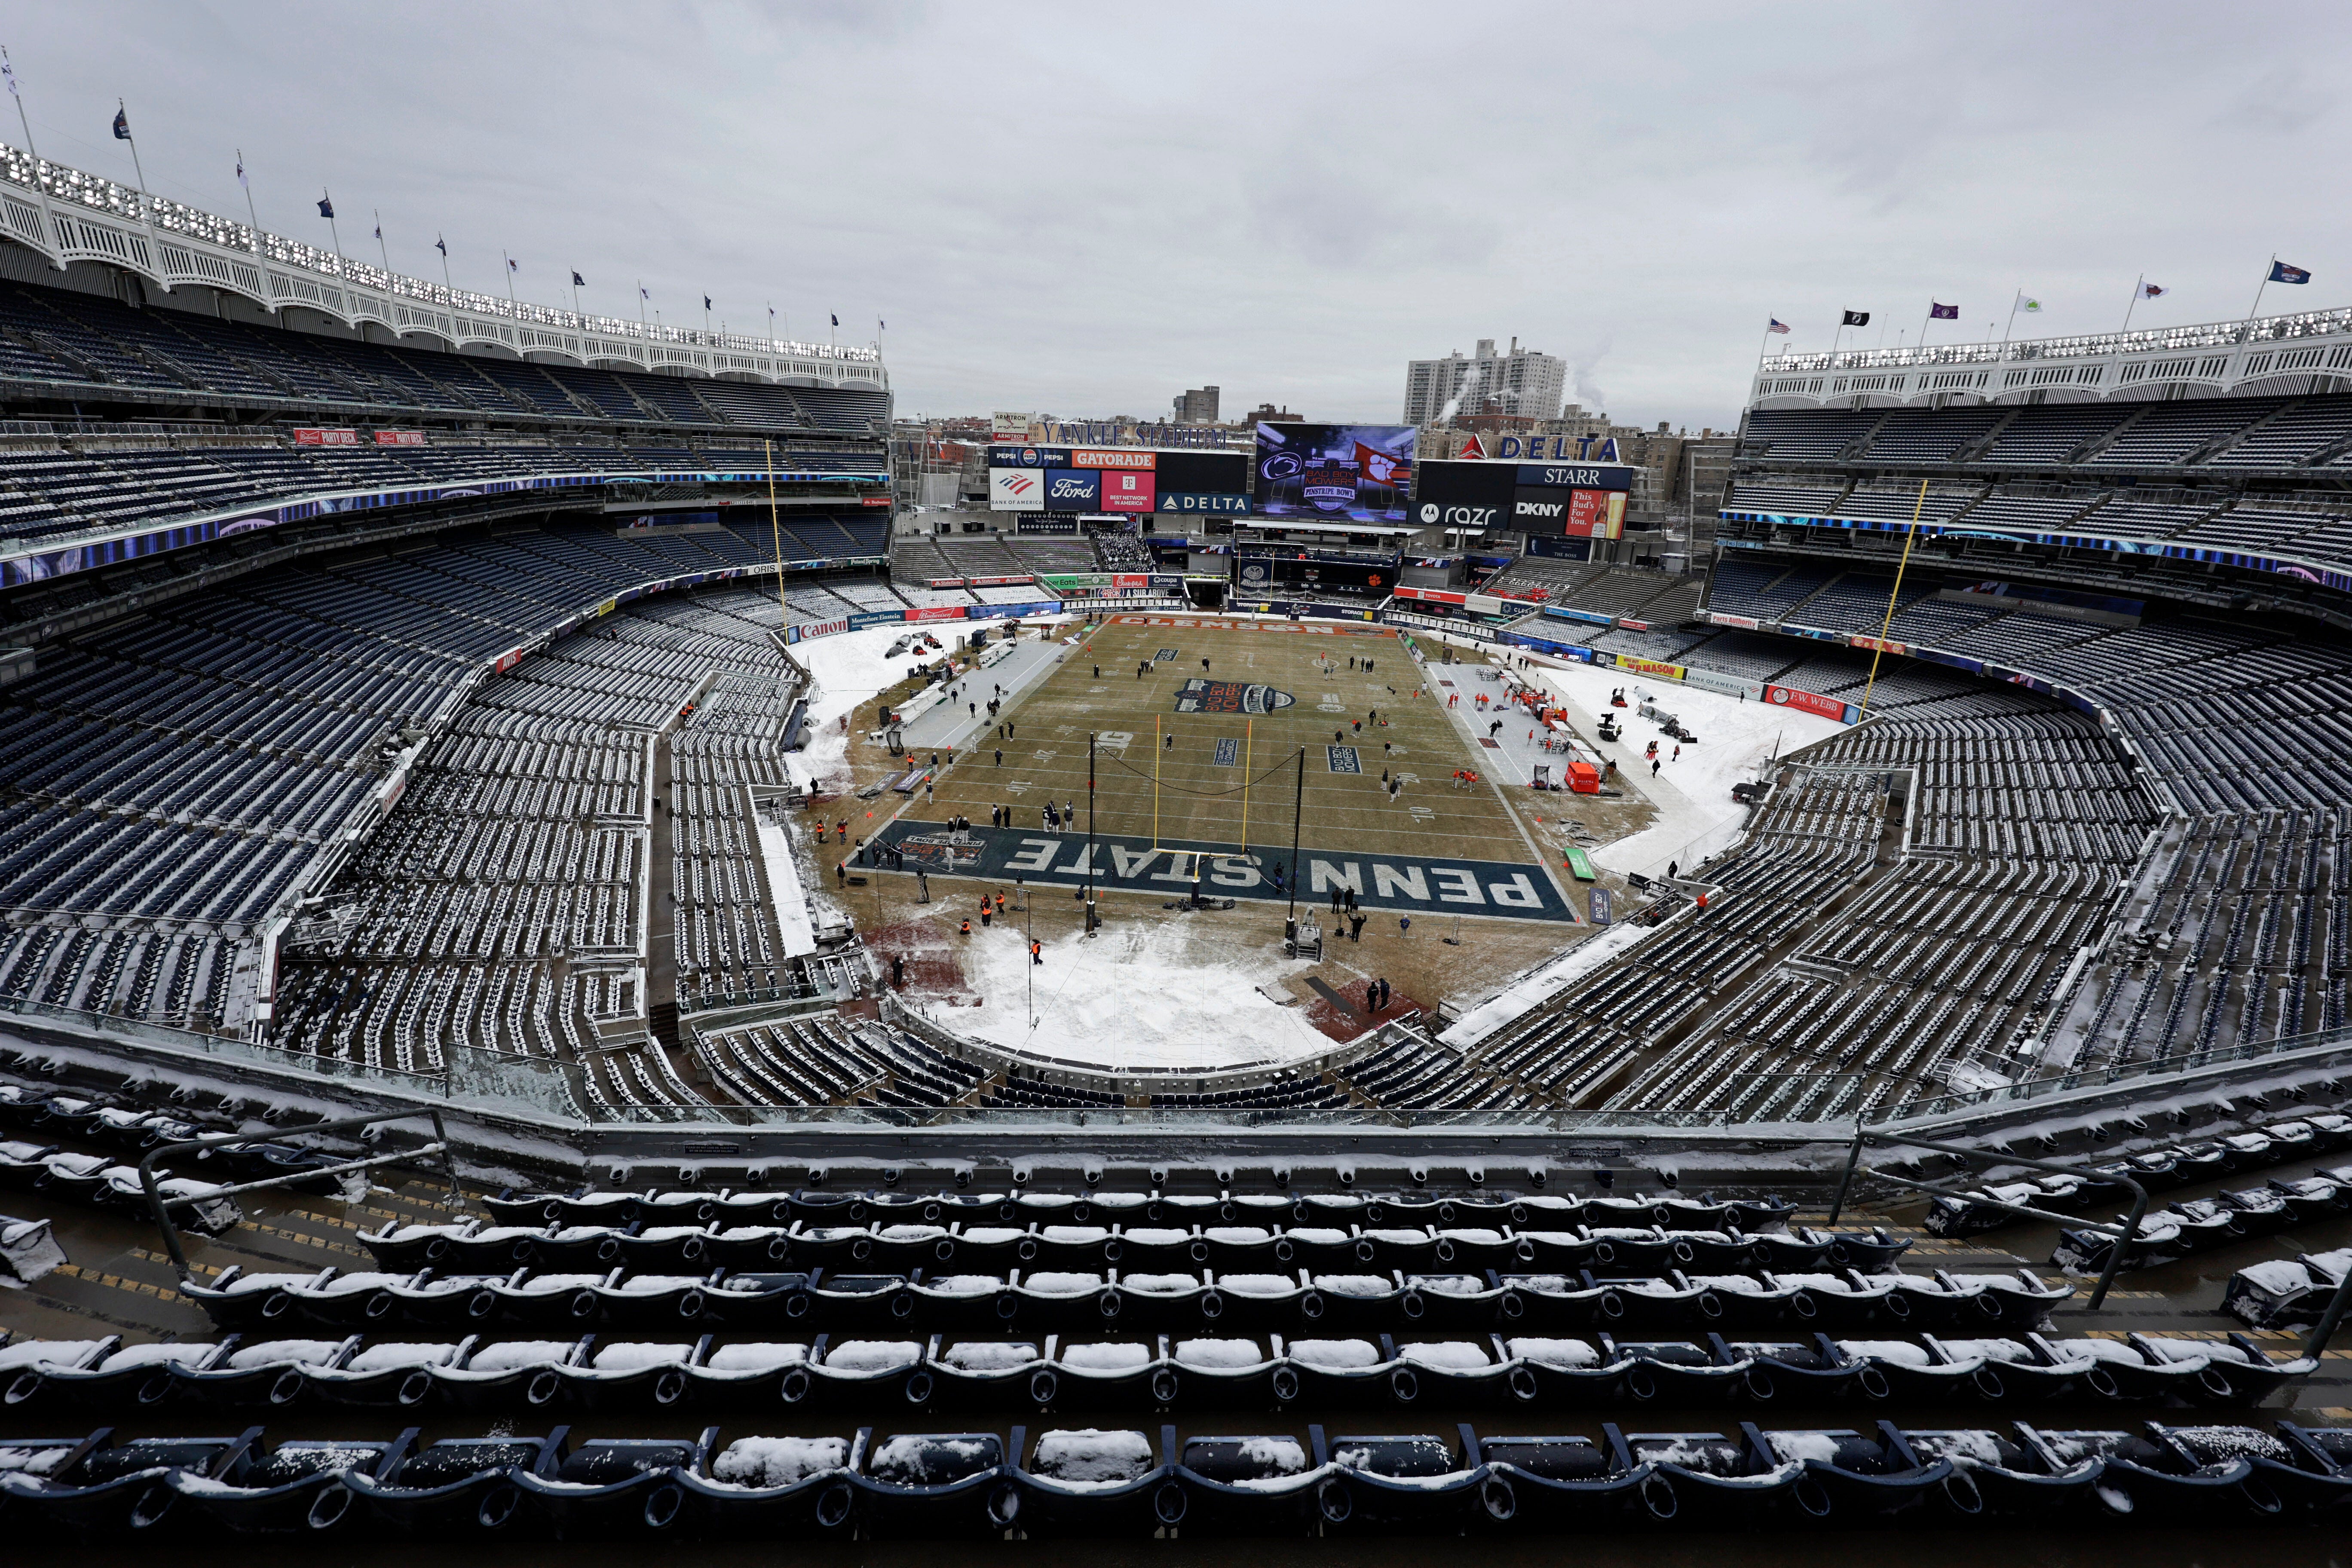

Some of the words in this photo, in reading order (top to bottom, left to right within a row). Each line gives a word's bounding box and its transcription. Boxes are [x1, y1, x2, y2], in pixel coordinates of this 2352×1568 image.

[322, 432, 340, 443] PARTY
[341, 432, 356, 443] DECK
[395, 434, 411, 443] PARTY
[411, 434, 423, 443] DECK
[1043, 423, 1122, 445] YANKEE
[1135, 426, 1227, 450] STADIUM
[1501, 437, 1621, 462] DELTA
[1077, 453, 1152, 467] GATORADE
[1305, 478, 1355, 486] MOWERS
[1544, 469, 1600, 485] STARR
[1051, 479, 1094, 499] Ford
[1305, 488, 1334, 496] PINSTRIPE
[1336, 489, 1354, 497] BOWL
[1574, 492, 1592, 500] This
[1184, 496, 1246, 510] DELTA
[1572, 500, 1594, 509] Bud's
[1516, 502, 1563, 517] DKNY
[1571, 508, 1585, 517] For
[1445, 507, 1497, 525] razr
[1570, 517, 1587, 525] You.
[753, 565, 775, 574] ORIS
[1126, 589, 1131, 597] A
[1133, 589, 1146, 597] SUB
[1148, 589, 1169, 597] ABOVE
[919, 611, 951, 620] Budweiser
[2047, 604, 2085, 615] CLUBHOUSE
[1728, 617, 1756, 627] Authority
[801, 620, 847, 639] Canon
[502, 652, 516, 669] AVIS
[1643, 664, 1676, 675] MASON
[1210, 683, 1225, 695] BOY
[1714, 680, 1745, 691] AMERICA
[1222, 683, 1242, 712] MOWERS
[1790, 692, 1807, 703] F.W.
[1811, 696, 1838, 711] WEBB
[1205, 697, 1219, 711] BAD
[1032, 750, 1057, 760] 20
[1225, 739, 1237, 760] COMMERCIAL
[1334, 747, 1342, 758] BOY
[1335, 759, 1344, 771] BAD
[1343, 747, 1356, 772] MOWERS
[388, 778, 405, 806] KIKKOMAN
[1006, 780, 1032, 792] 10
[1409, 807, 1436, 820] 10
[1004, 838, 1262, 888] STATE
[1311, 858, 1545, 909] PENN
